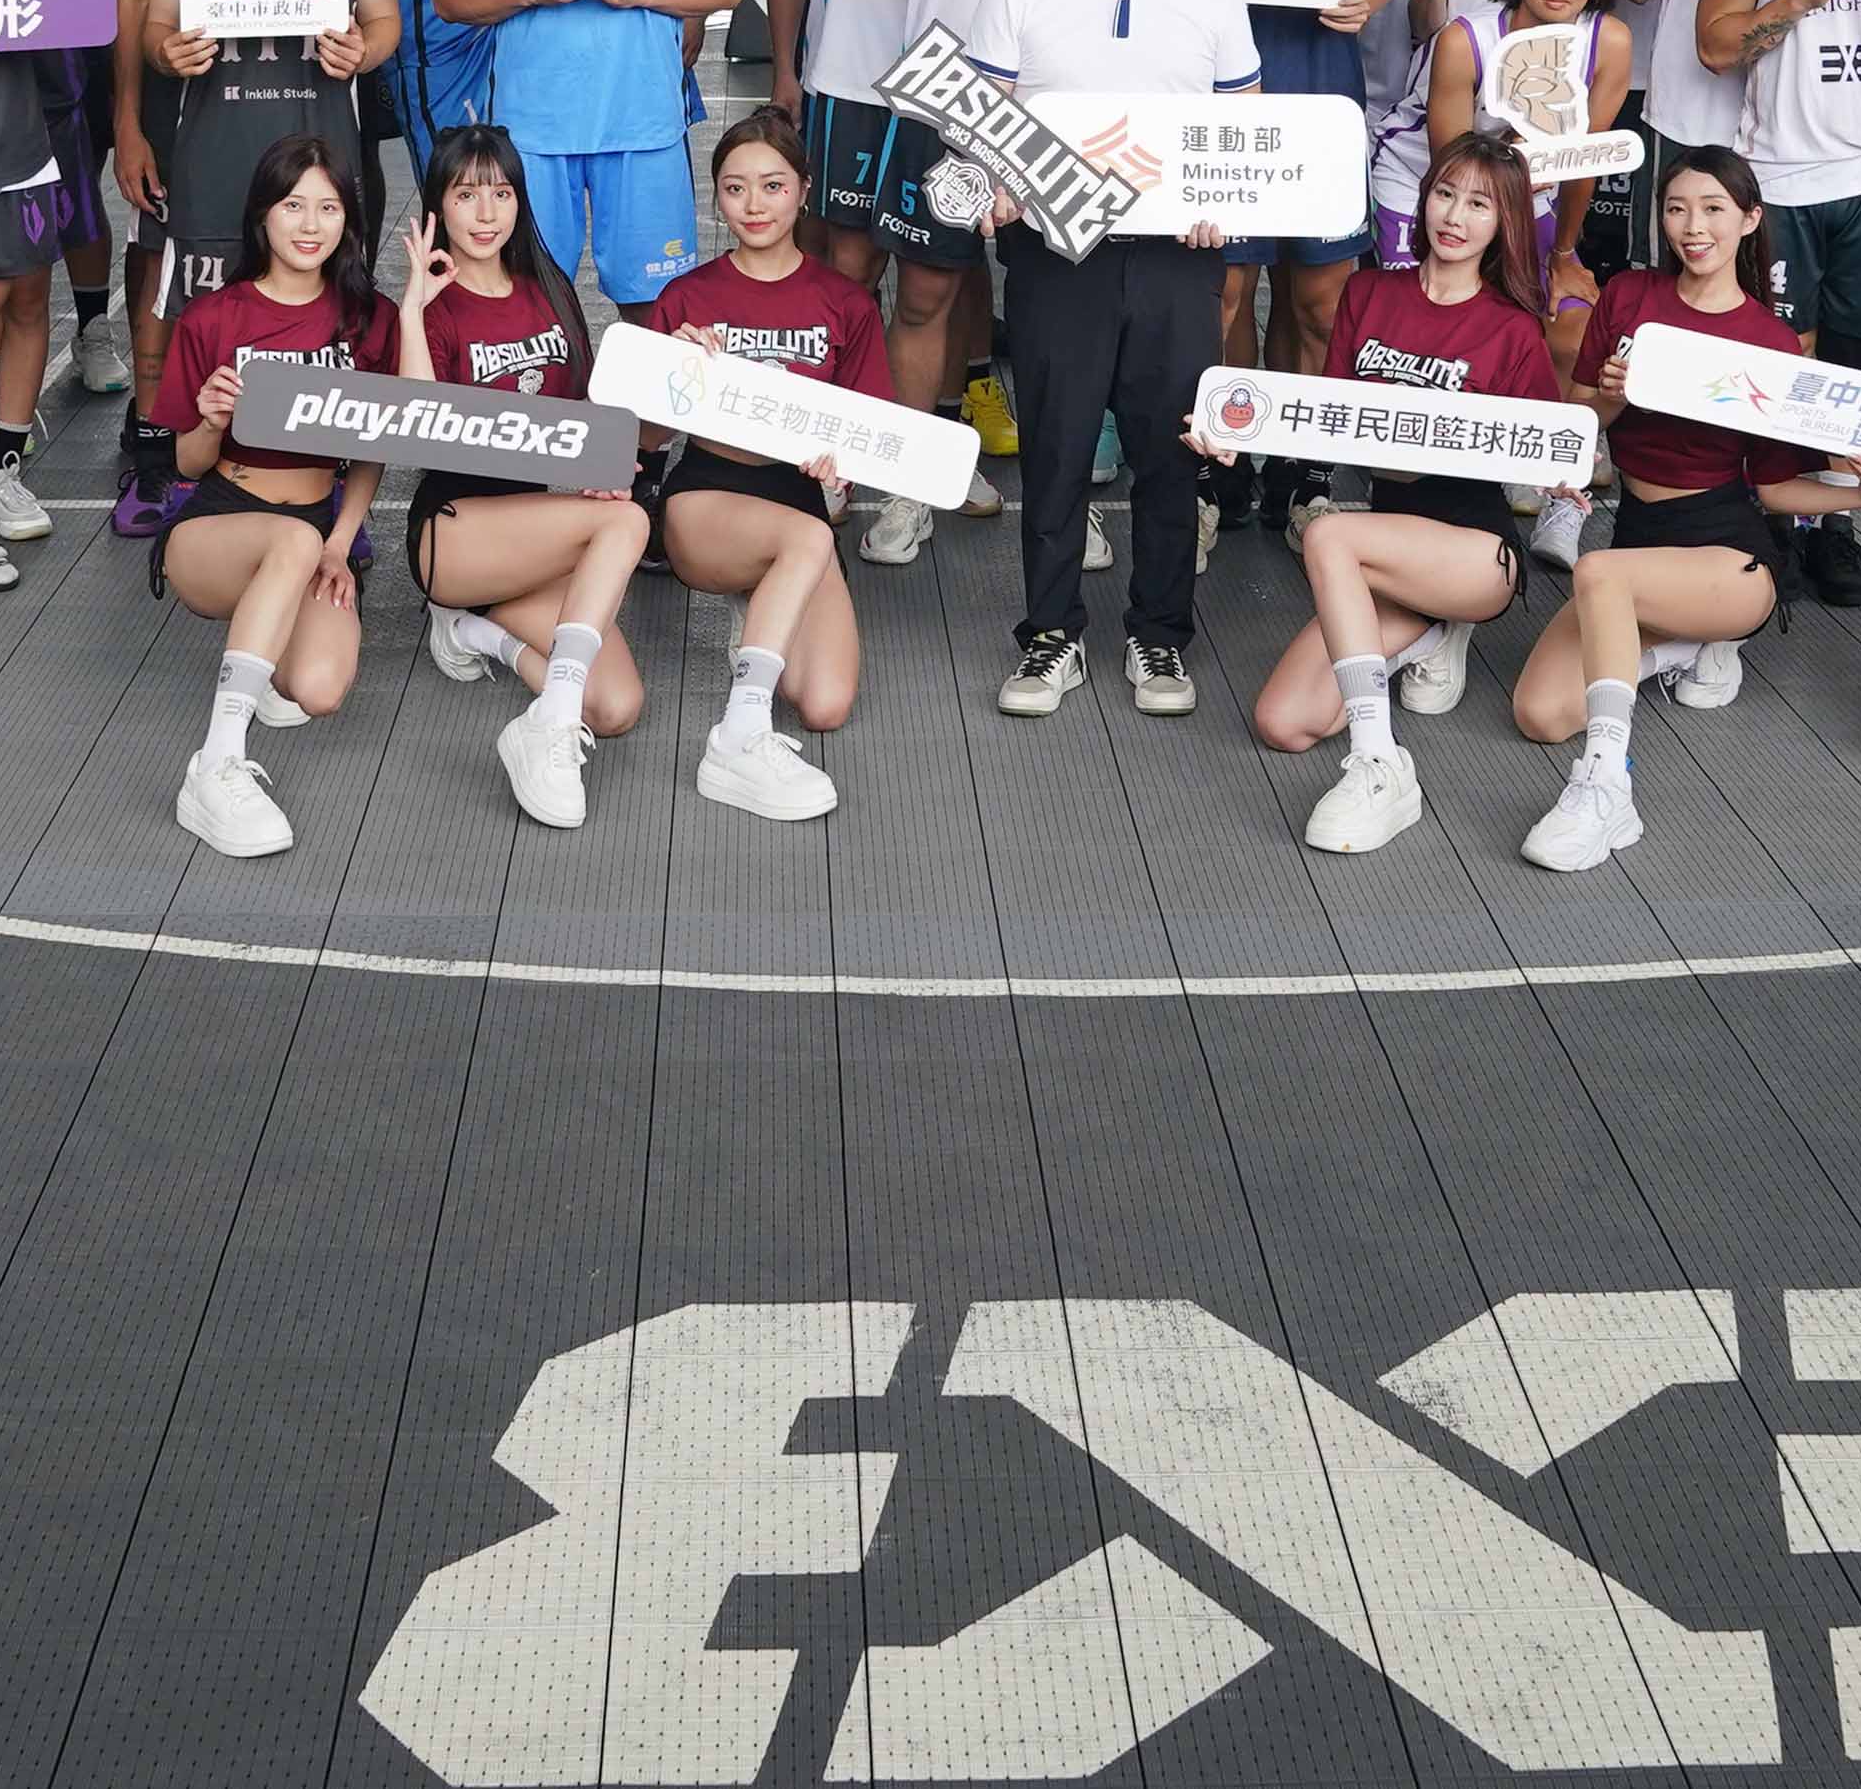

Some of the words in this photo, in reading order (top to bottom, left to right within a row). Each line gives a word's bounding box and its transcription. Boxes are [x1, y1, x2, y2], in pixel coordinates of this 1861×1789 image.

[880, 24, 1137, 256] ABSOLUTE
[1180, 124, 1283, 154] 運動部
[854, 151, 873, 185] 7
[1181, 162, 1274, 187] Ministry
[1278, 162, 1306, 183] of
[900, 179, 918, 217] 5
[1181, 184, 1259, 205] Sports
[878, 211, 931, 247] FOOTER
[468, 323, 570, 385] ABSOLUTE
[284, 388, 590, 460] play.fiba3x3
[716, 382, 906, 465] 仕安物理治療
[1277, 398, 1587, 466] 中華民國籃球協會
